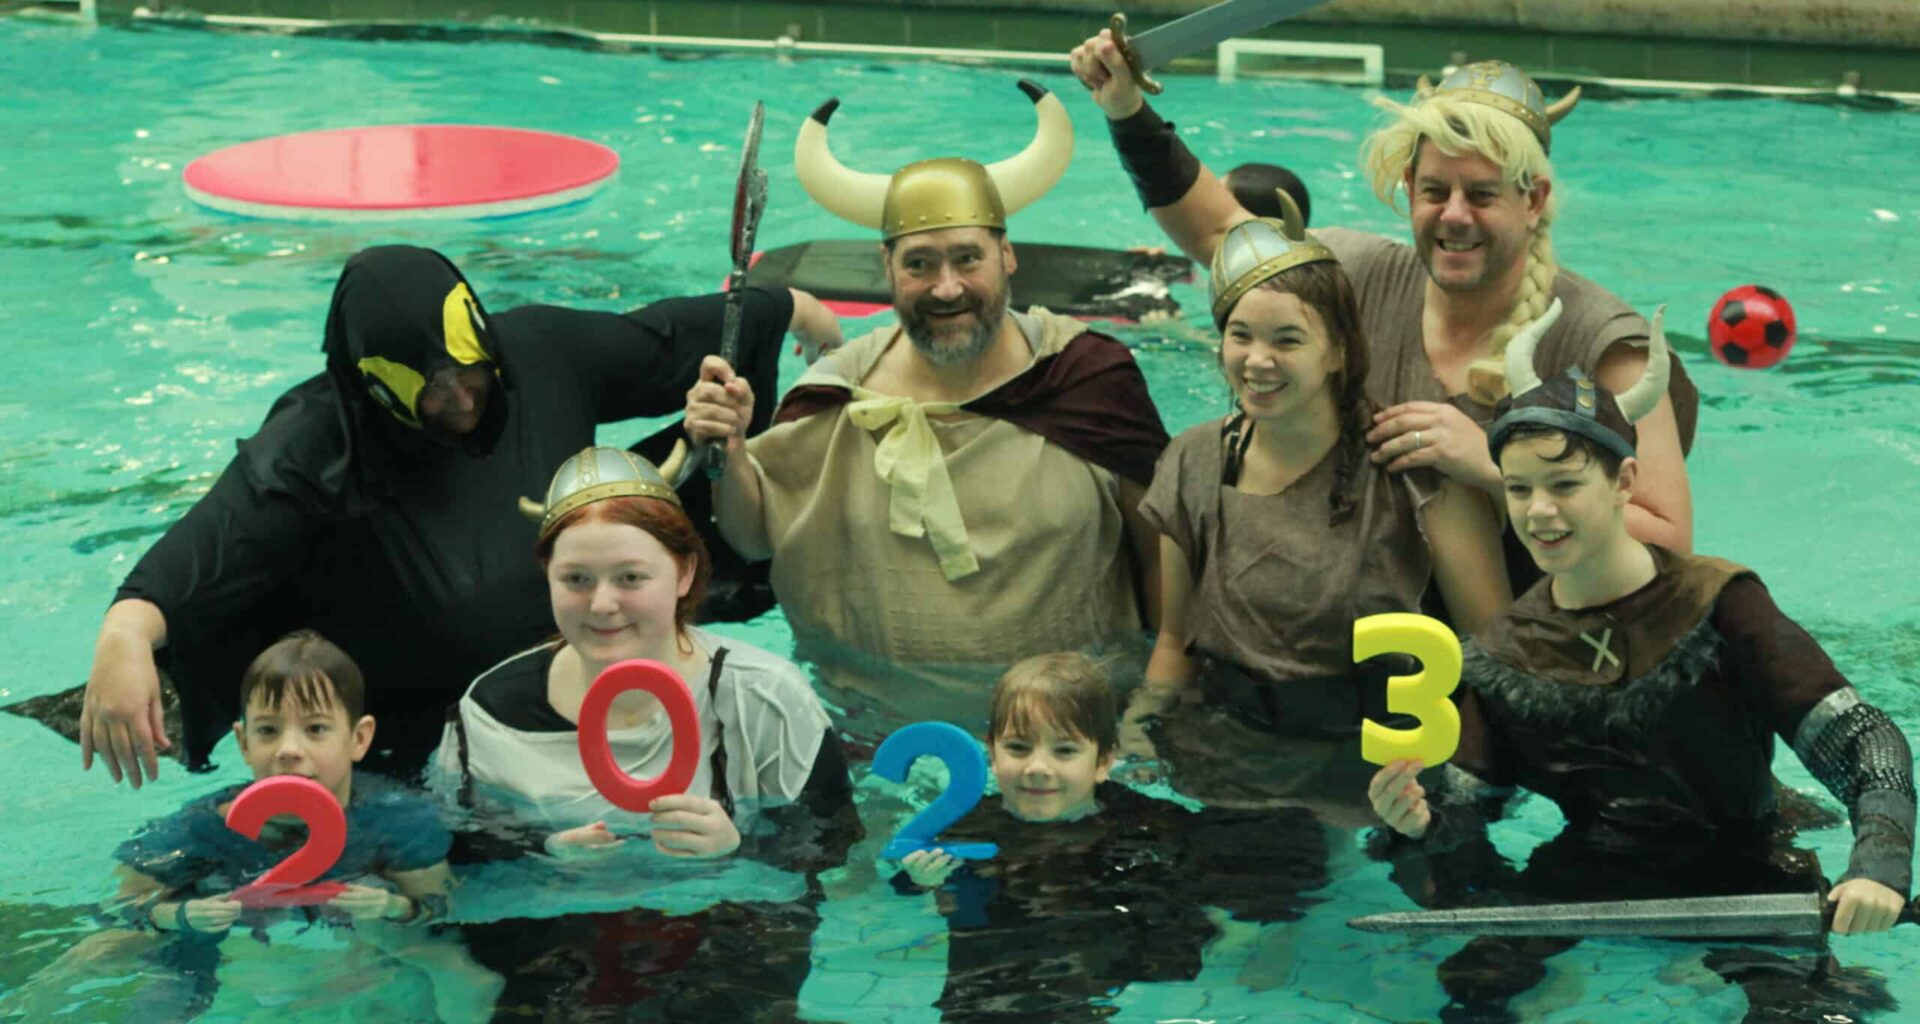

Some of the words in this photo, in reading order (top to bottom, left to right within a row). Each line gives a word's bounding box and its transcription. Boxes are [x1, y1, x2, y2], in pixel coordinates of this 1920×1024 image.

[577, 658, 701, 813] 0
[1353, 612, 1463, 768] 3
[225, 774, 348, 908] 2
[871, 720, 998, 860] 2
